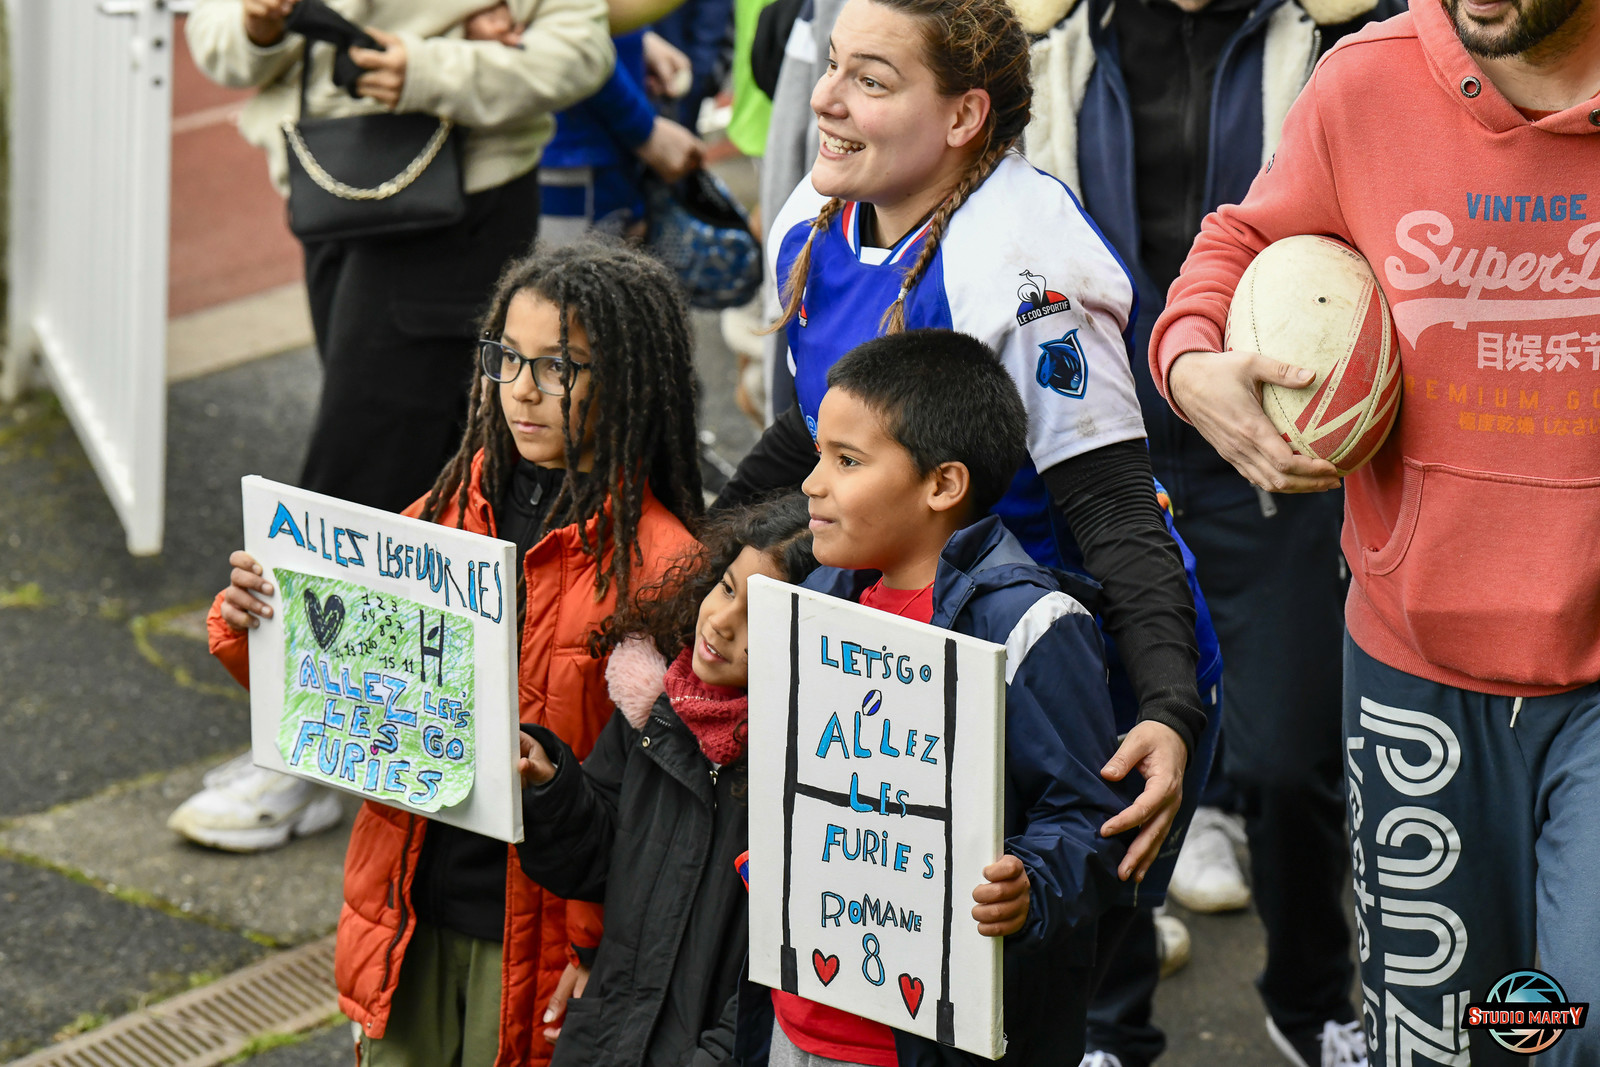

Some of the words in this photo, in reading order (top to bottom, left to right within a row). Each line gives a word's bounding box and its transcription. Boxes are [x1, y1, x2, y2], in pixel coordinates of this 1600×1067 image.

[1466, 192, 1588, 222] VINTAGE
[1018, 314, 1028, 324] LE
[1028, 309, 1041, 320] COQ
[1042, 301, 1069, 315] SPORTIF
[361, 593, 370, 605] 1
[377, 596, 386, 611] 2
[391, 600, 398, 613] 3
[385, 615, 392, 627] 5
[379, 625, 385, 637] 8
[379, 655, 395, 669] 15
[402, 659, 414, 674] 11
[300, 654, 417, 728] ALLEZ
[324, 698, 398, 753] LES
[423, 725, 464, 760] GO
[816, 710, 940, 765] ALLEZ
[290, 720, 442, 805] FURIES
[849, 771, 909, 819] LES
[821, 823, 934, 880] FURIES
[821, 890, 922, 933] ROMANE
[861, 932, 885, 987] 8
